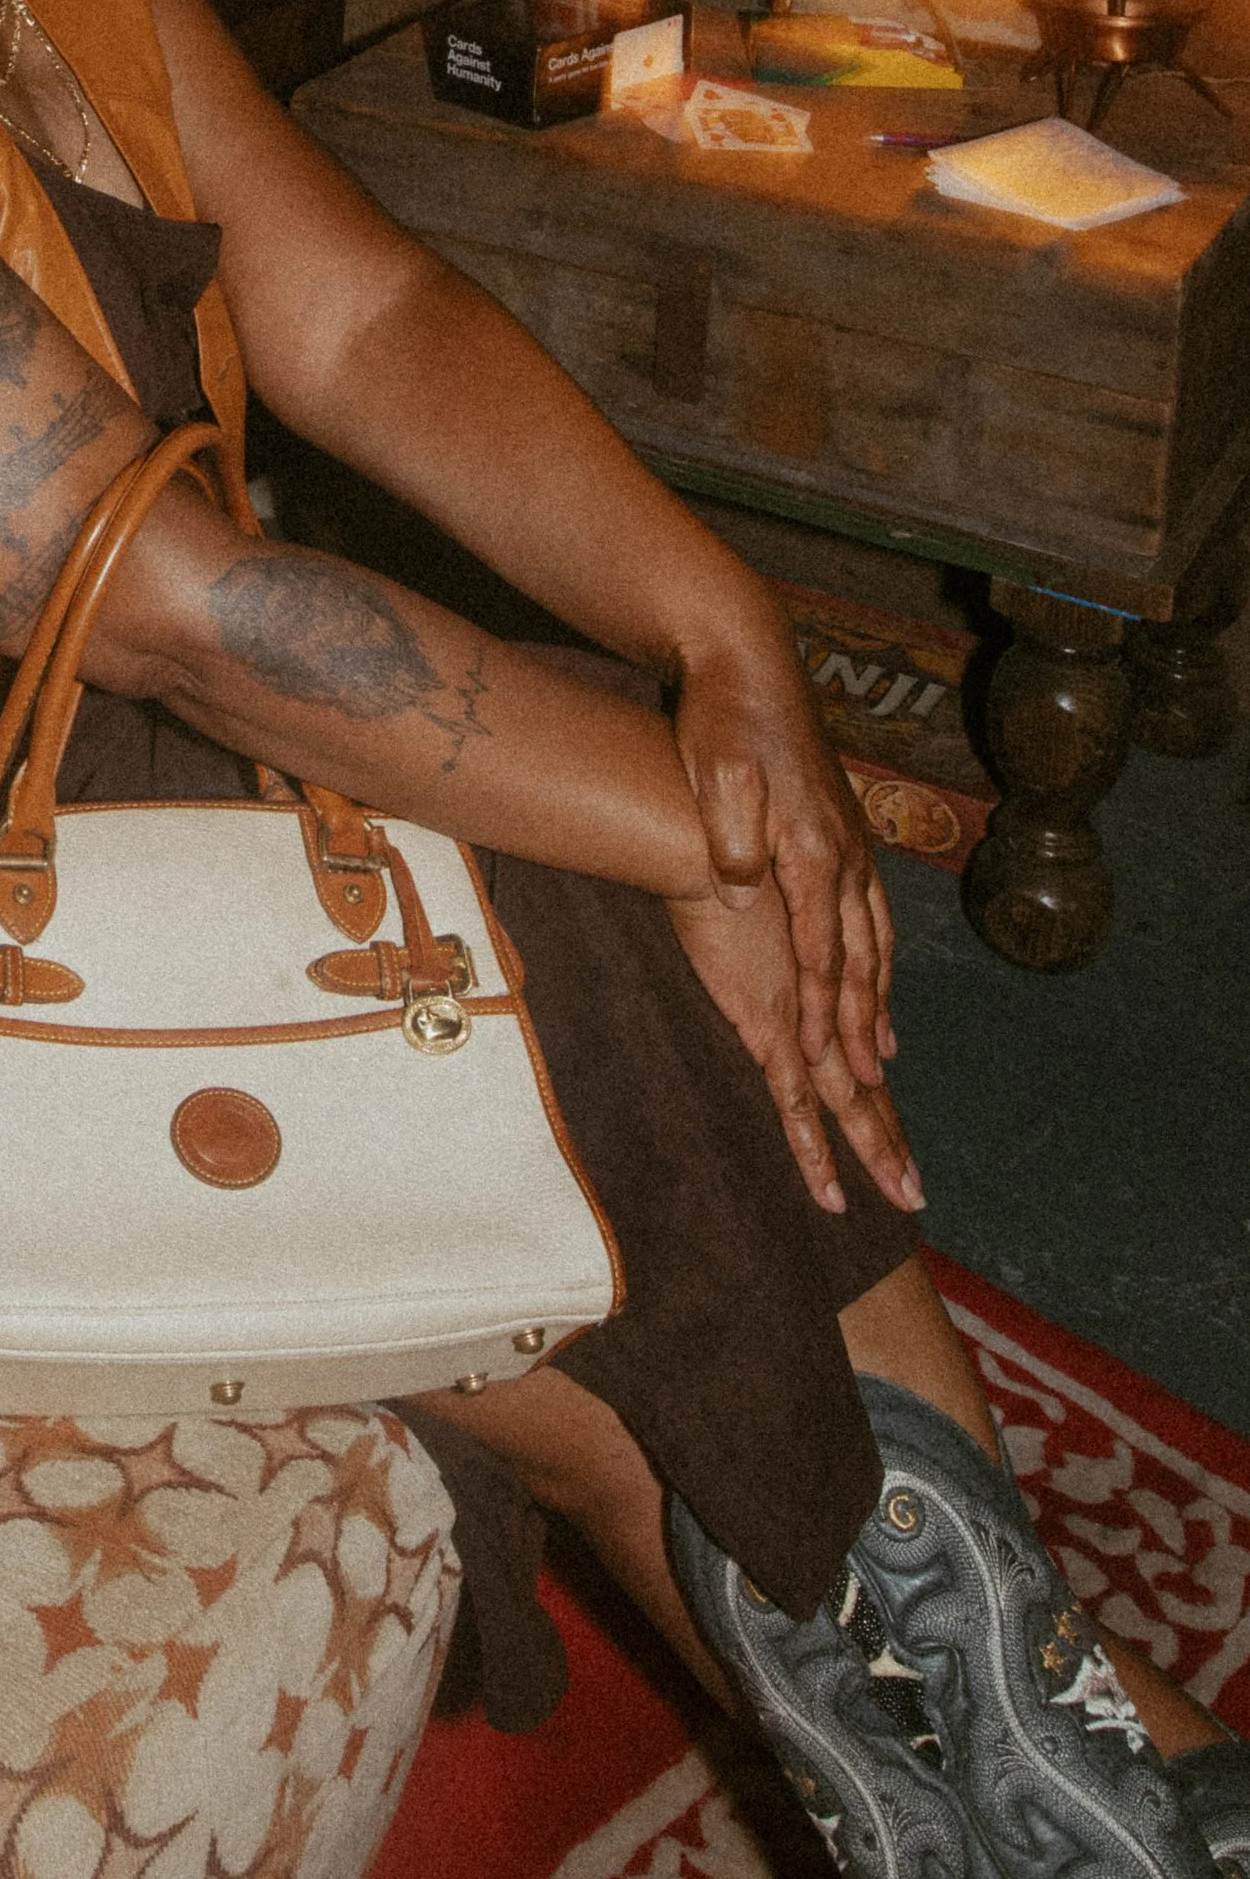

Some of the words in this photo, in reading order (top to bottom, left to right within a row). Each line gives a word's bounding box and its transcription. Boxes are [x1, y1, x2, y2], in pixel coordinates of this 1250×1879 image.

[447, 34, 483, 56] Cards
[447, 49, 491, 73] Against
[548, 53, 579, 72] Cards
[446, 62, 502, 92] Humanity
[797, 641, 948, 718] NJI
